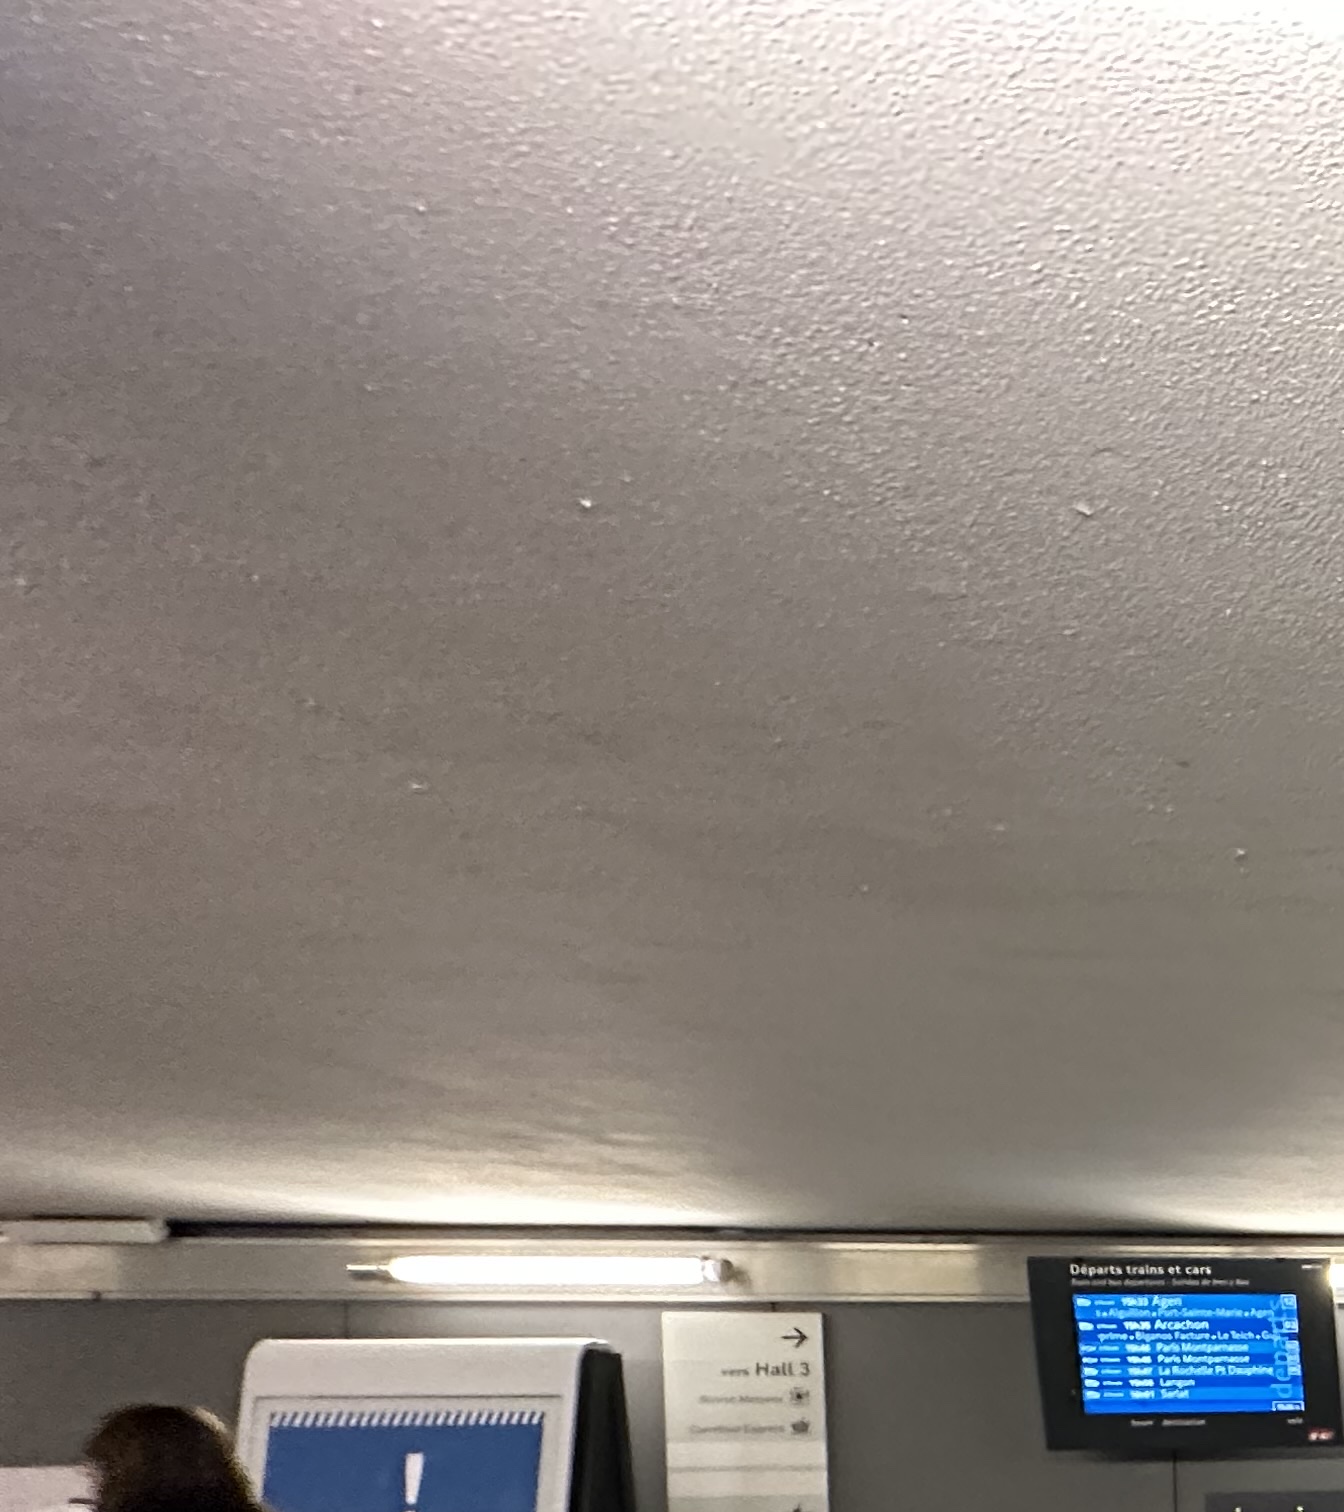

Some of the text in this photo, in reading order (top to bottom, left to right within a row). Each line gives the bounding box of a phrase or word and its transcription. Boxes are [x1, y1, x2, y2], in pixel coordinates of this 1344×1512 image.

[1070, 1264, 1212, 1277] Départs trains et cars
[1154, 1319, 1209, 1331] Arcachon
[1217, 1331, 1229, 1340] Le
[1230, 1330, 1255, 1340] Teich
[1181, 1342, 1250, 1354] Montparnasse
[1157, 1354, 1251, 1365] Paris Montparnasse
[756, 1362, 794, 1376] Hall
[800, 1362, 811, 1376] 3
